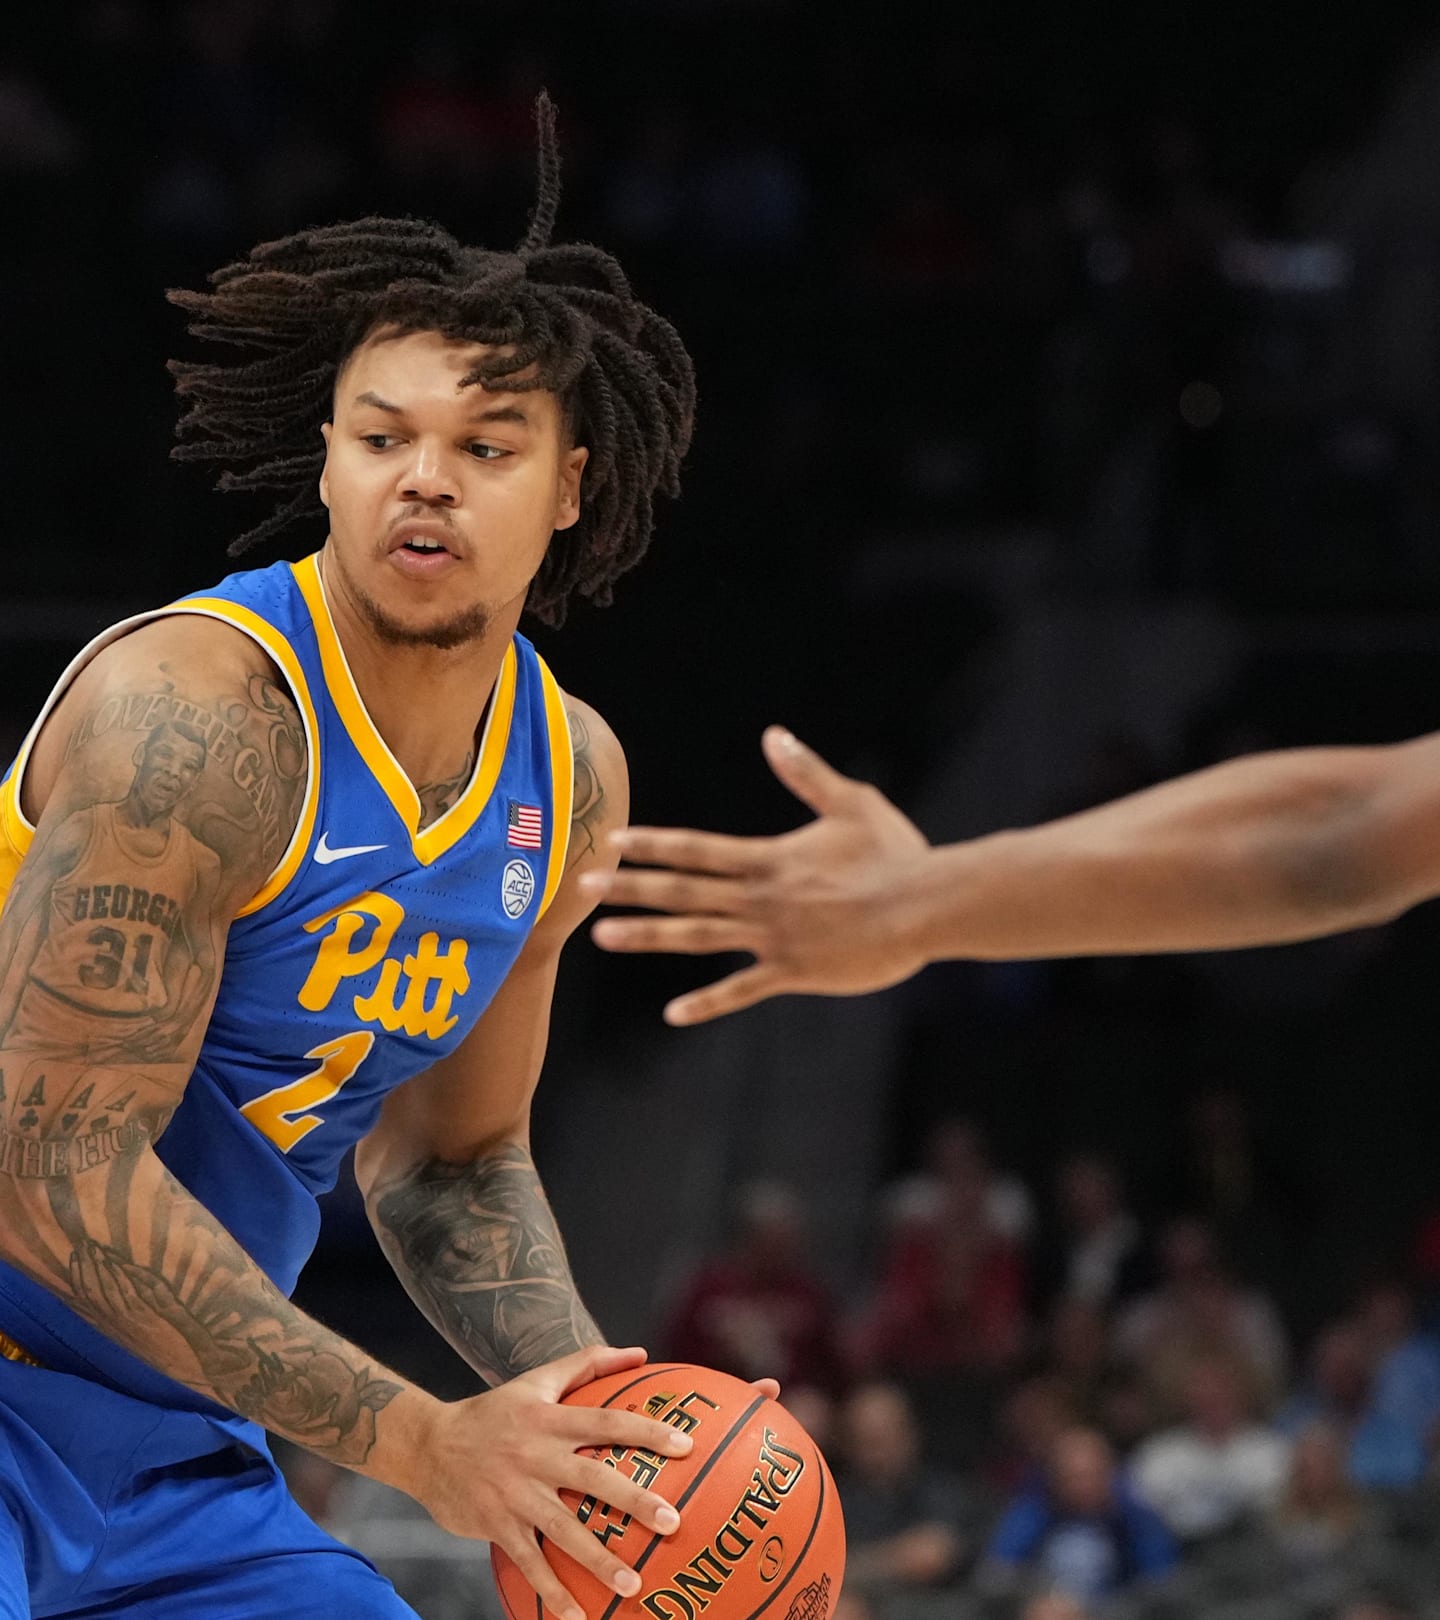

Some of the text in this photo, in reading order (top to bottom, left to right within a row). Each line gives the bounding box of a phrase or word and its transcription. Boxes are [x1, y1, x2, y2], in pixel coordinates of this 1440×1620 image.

[507, 880, 532, 894] ACC
[77, 925, 155, 996] 31
[297, 890, 471, 1041] Pitt
[239, 1030, 375, 1155] 2
[0, 1127, 71, 1179] THE
[640, 1426, 806, 1620] SPALDING
